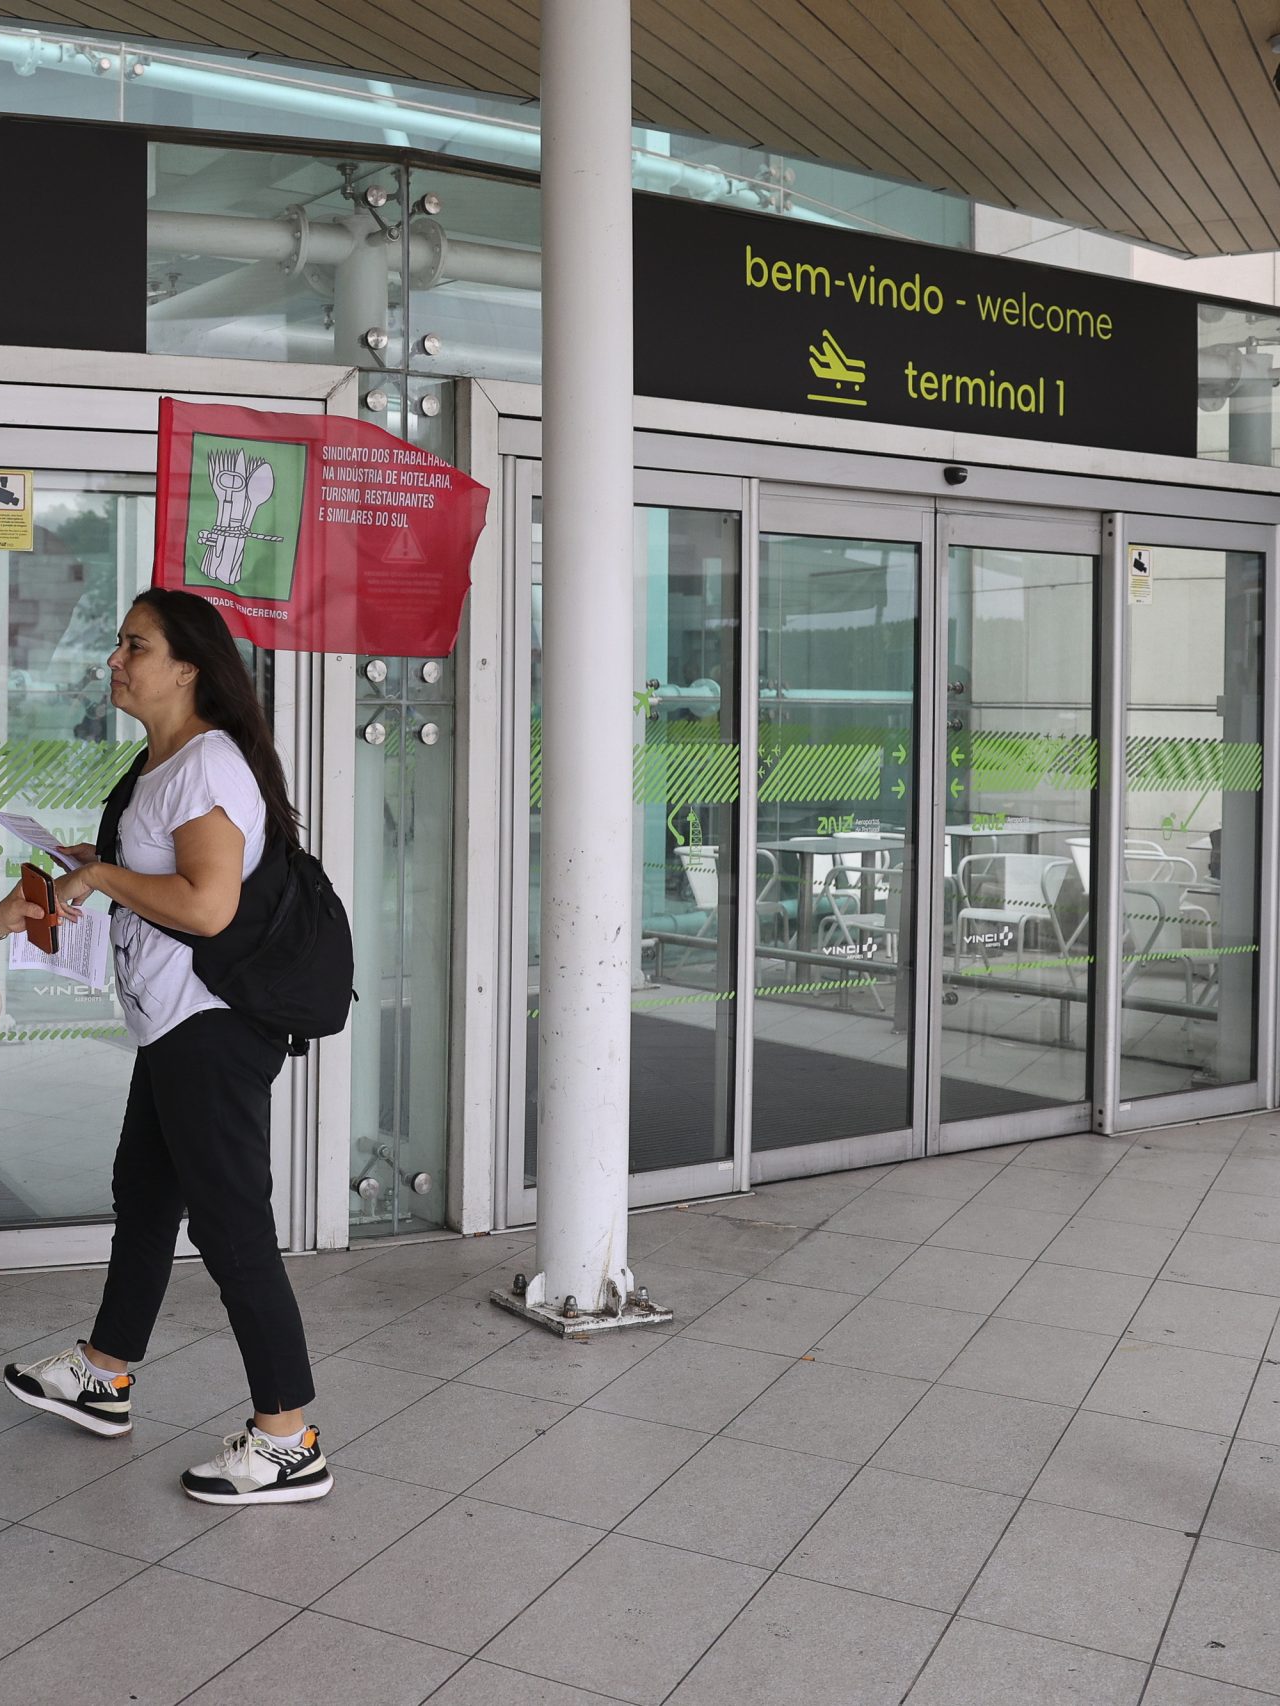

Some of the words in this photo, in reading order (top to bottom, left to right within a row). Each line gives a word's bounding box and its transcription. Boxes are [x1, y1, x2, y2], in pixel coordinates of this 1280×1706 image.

[745, 244, 945, 315] bem-vindo
[977, 291, 1114, 341] welcome
[905, 361, 1045, 414] terminal
[1055, 379, 1066, 417] 1
[322, 445, 368, 462] SINDICATO
[371, 448, 390, 464] DOS
[322, 465, 335, 480] NA
[337, 465, 383, 484] INDÚSTRIA
[385, 470, 398, 485] DE
[400, 471, 453, 491] HOTELARIA,
[321, 486, 362, 505] TURISMO,
[364, 489, 435, 509] RESTAURANTES
[318, 507, 325, 521] E
[326, 507, 373, 525] SIMILARES
[375, 511, 389, 527] DO
[391, 512, 409, 528] SUL
[963, 933, 998, 944] VINCI
[822, 944, 860, 955] VINCI
[33, 984, 97, 996] VINCI
